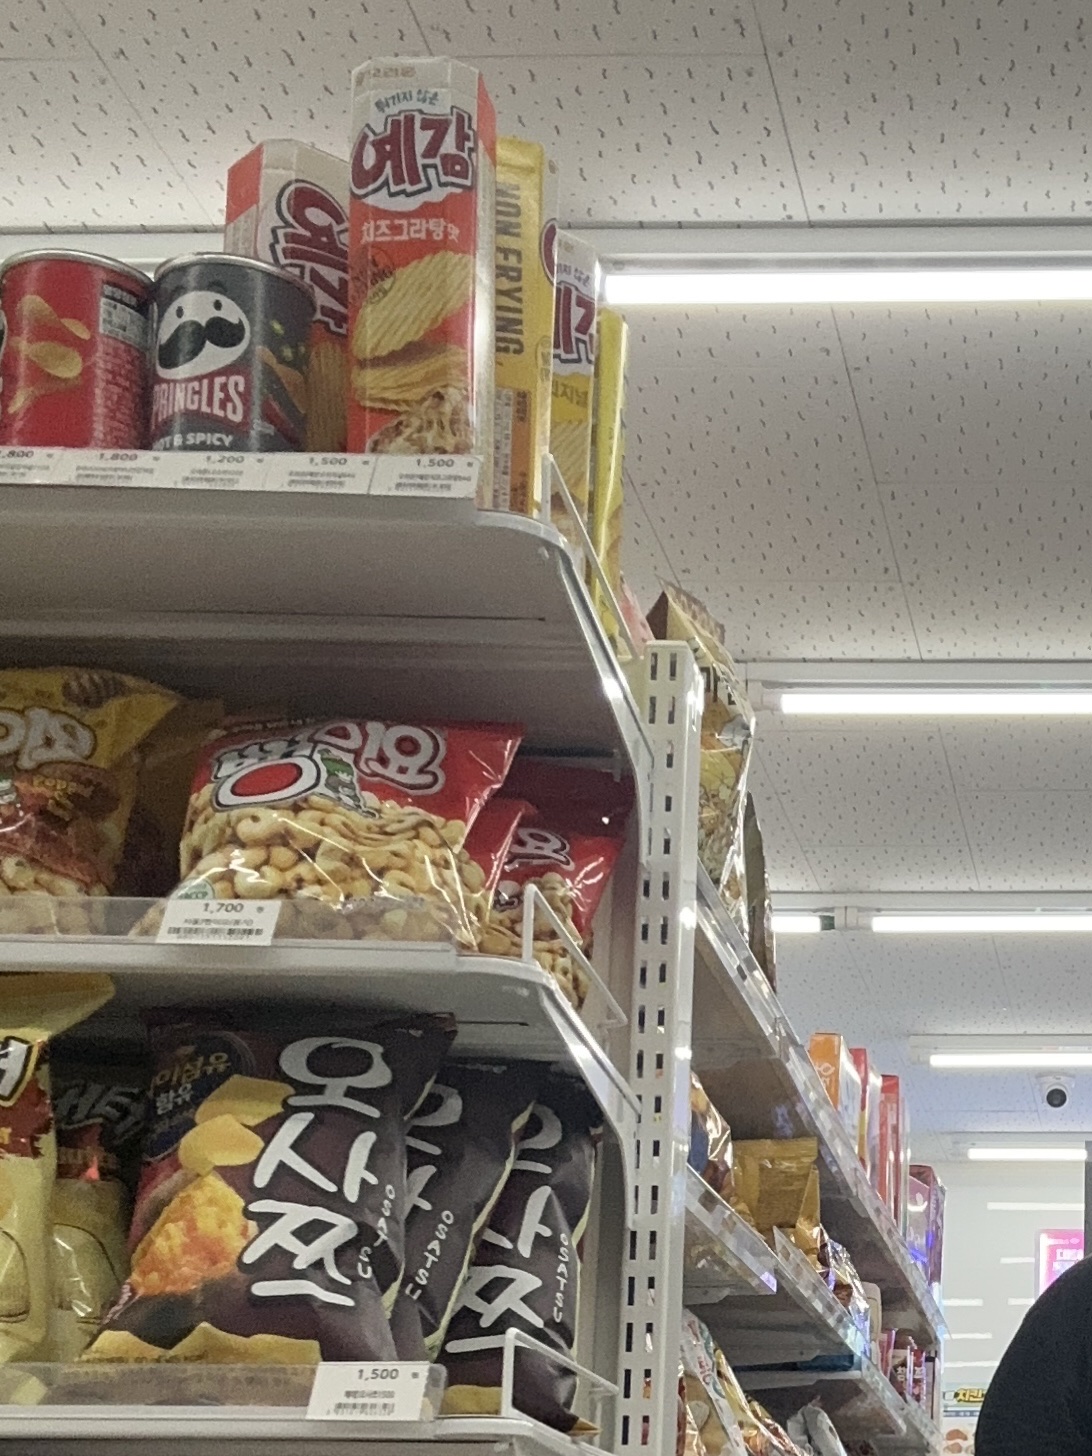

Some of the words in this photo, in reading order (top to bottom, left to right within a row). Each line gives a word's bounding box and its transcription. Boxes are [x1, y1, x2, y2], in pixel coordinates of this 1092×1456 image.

[351, 107, 474, 197] 예감
[361, 217, 460, 243] 치즈그라탕맛
[496, 184, 521, 243] NON
[496, 245, 524, 356] FRYING
[152, 374, 246, 431] PRINGLES
[187, 432, 234, 447] SPICY
[309, 456, 347, 467] 1,500
[416, 458, 454, 468] 1,500
[203, 902, 244, 914] 1,700
[242, 1036, 393, 1307] 오사쯔
[405, 1210, 454, 1301] OSATSU
[553, 1232, 569, 1323] OSATSU
[357, 1368, 399, 1381] 1,500
